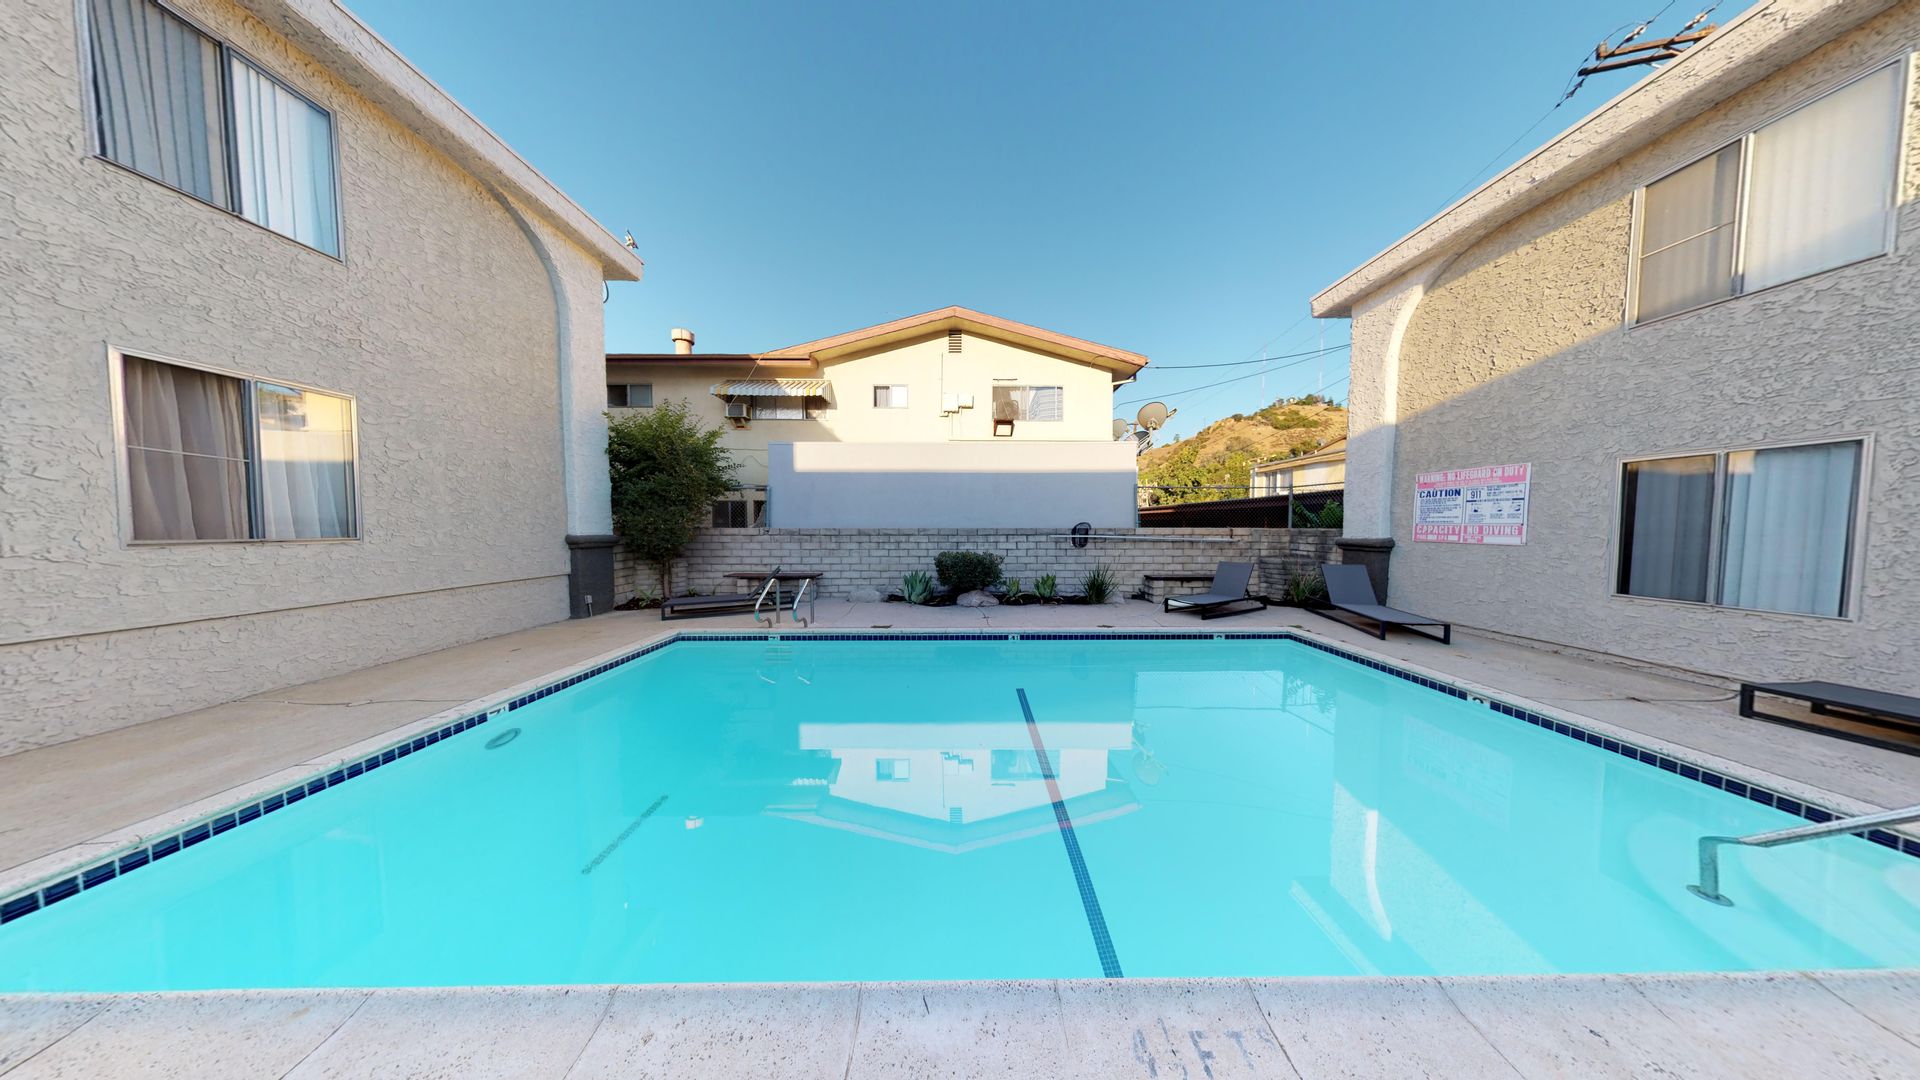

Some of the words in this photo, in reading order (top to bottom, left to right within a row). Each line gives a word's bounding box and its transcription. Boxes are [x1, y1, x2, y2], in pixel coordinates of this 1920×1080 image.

[1457, 468, 1491, 481] LIFEGUARD
[1504, 464, 1524, 477] DUTY
[1419, 488, 1461, 498] CAUTION
[1470, 490, 1482, 499] 911
[1416, 524, 1460, 535] CAPACITY
[1467, 525, 1479, 535] NO
[1483, 525, 1519, 535] DIVING
